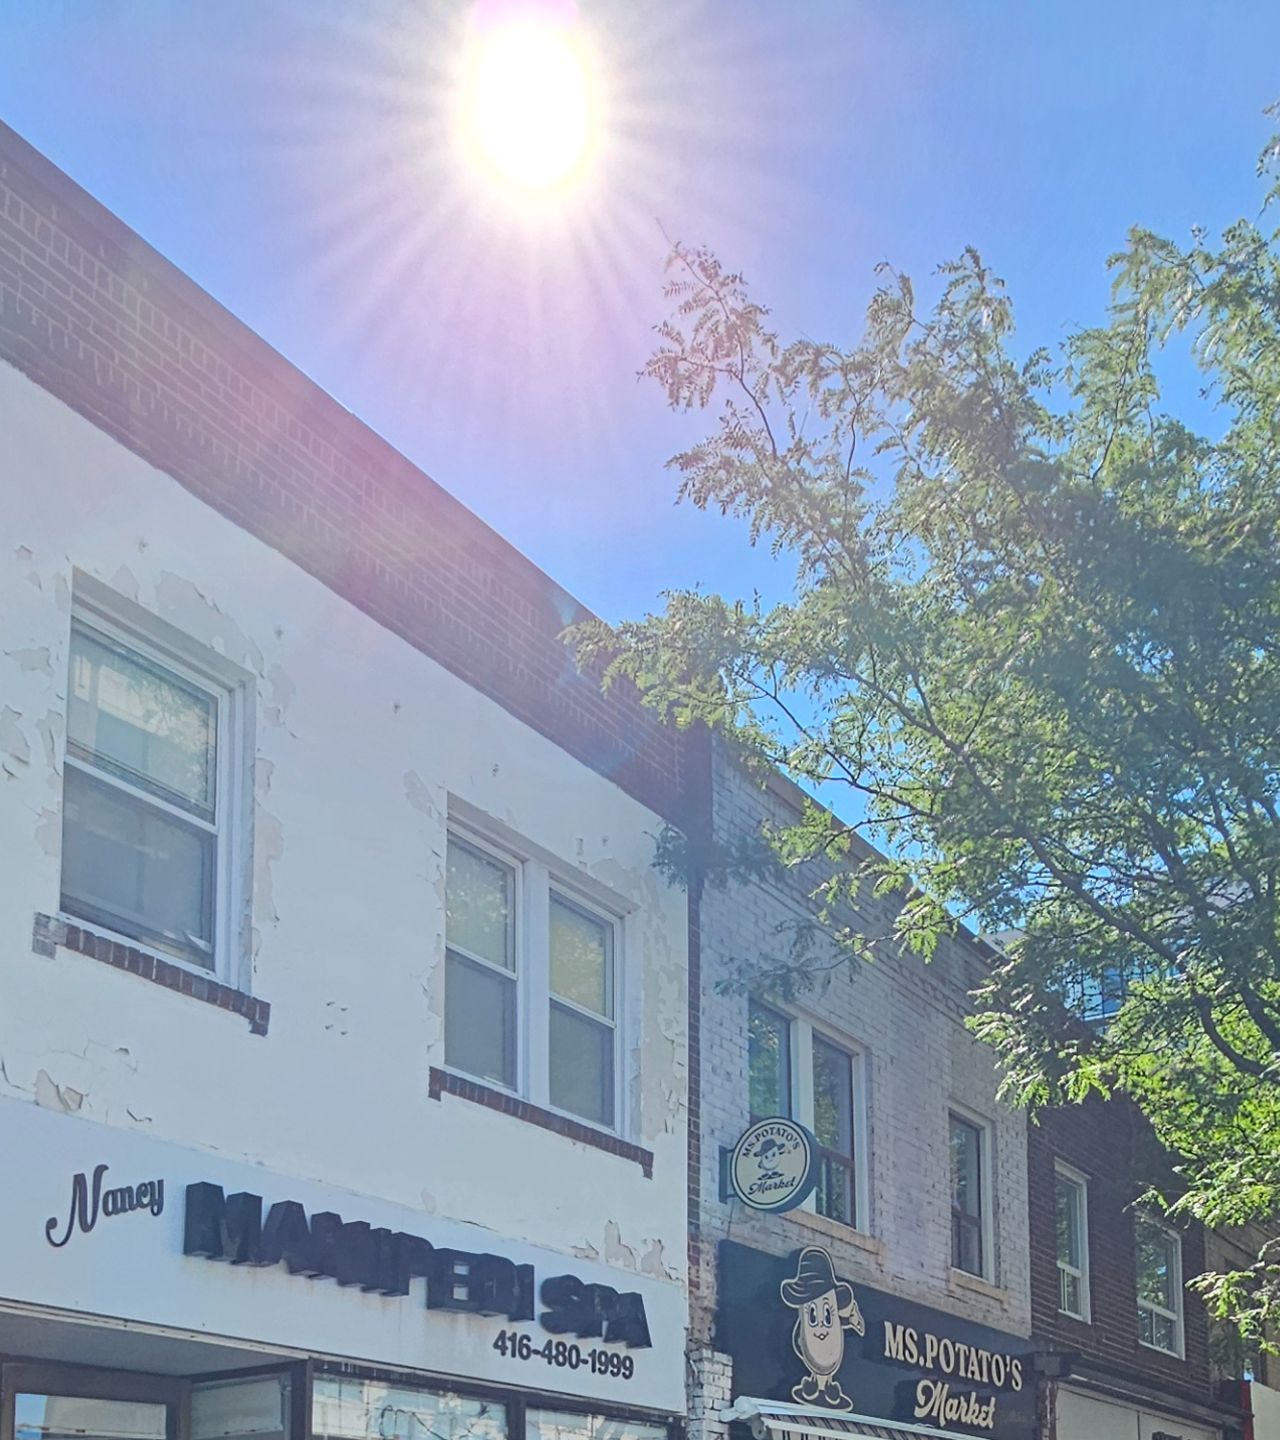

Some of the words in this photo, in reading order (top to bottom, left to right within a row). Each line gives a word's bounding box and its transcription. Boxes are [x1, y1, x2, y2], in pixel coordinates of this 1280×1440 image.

[45, 1164, 164, 1248] Nancy
[747, 1176, 796, 1195] Market
[540, 1273, 652, 1349] SPA
[493, 1329, 634, 1380] 416-480-1999
[884, 1321, 1022, 1392] MS.POTATO'S
[914, 1379, 996, 1429] Market
